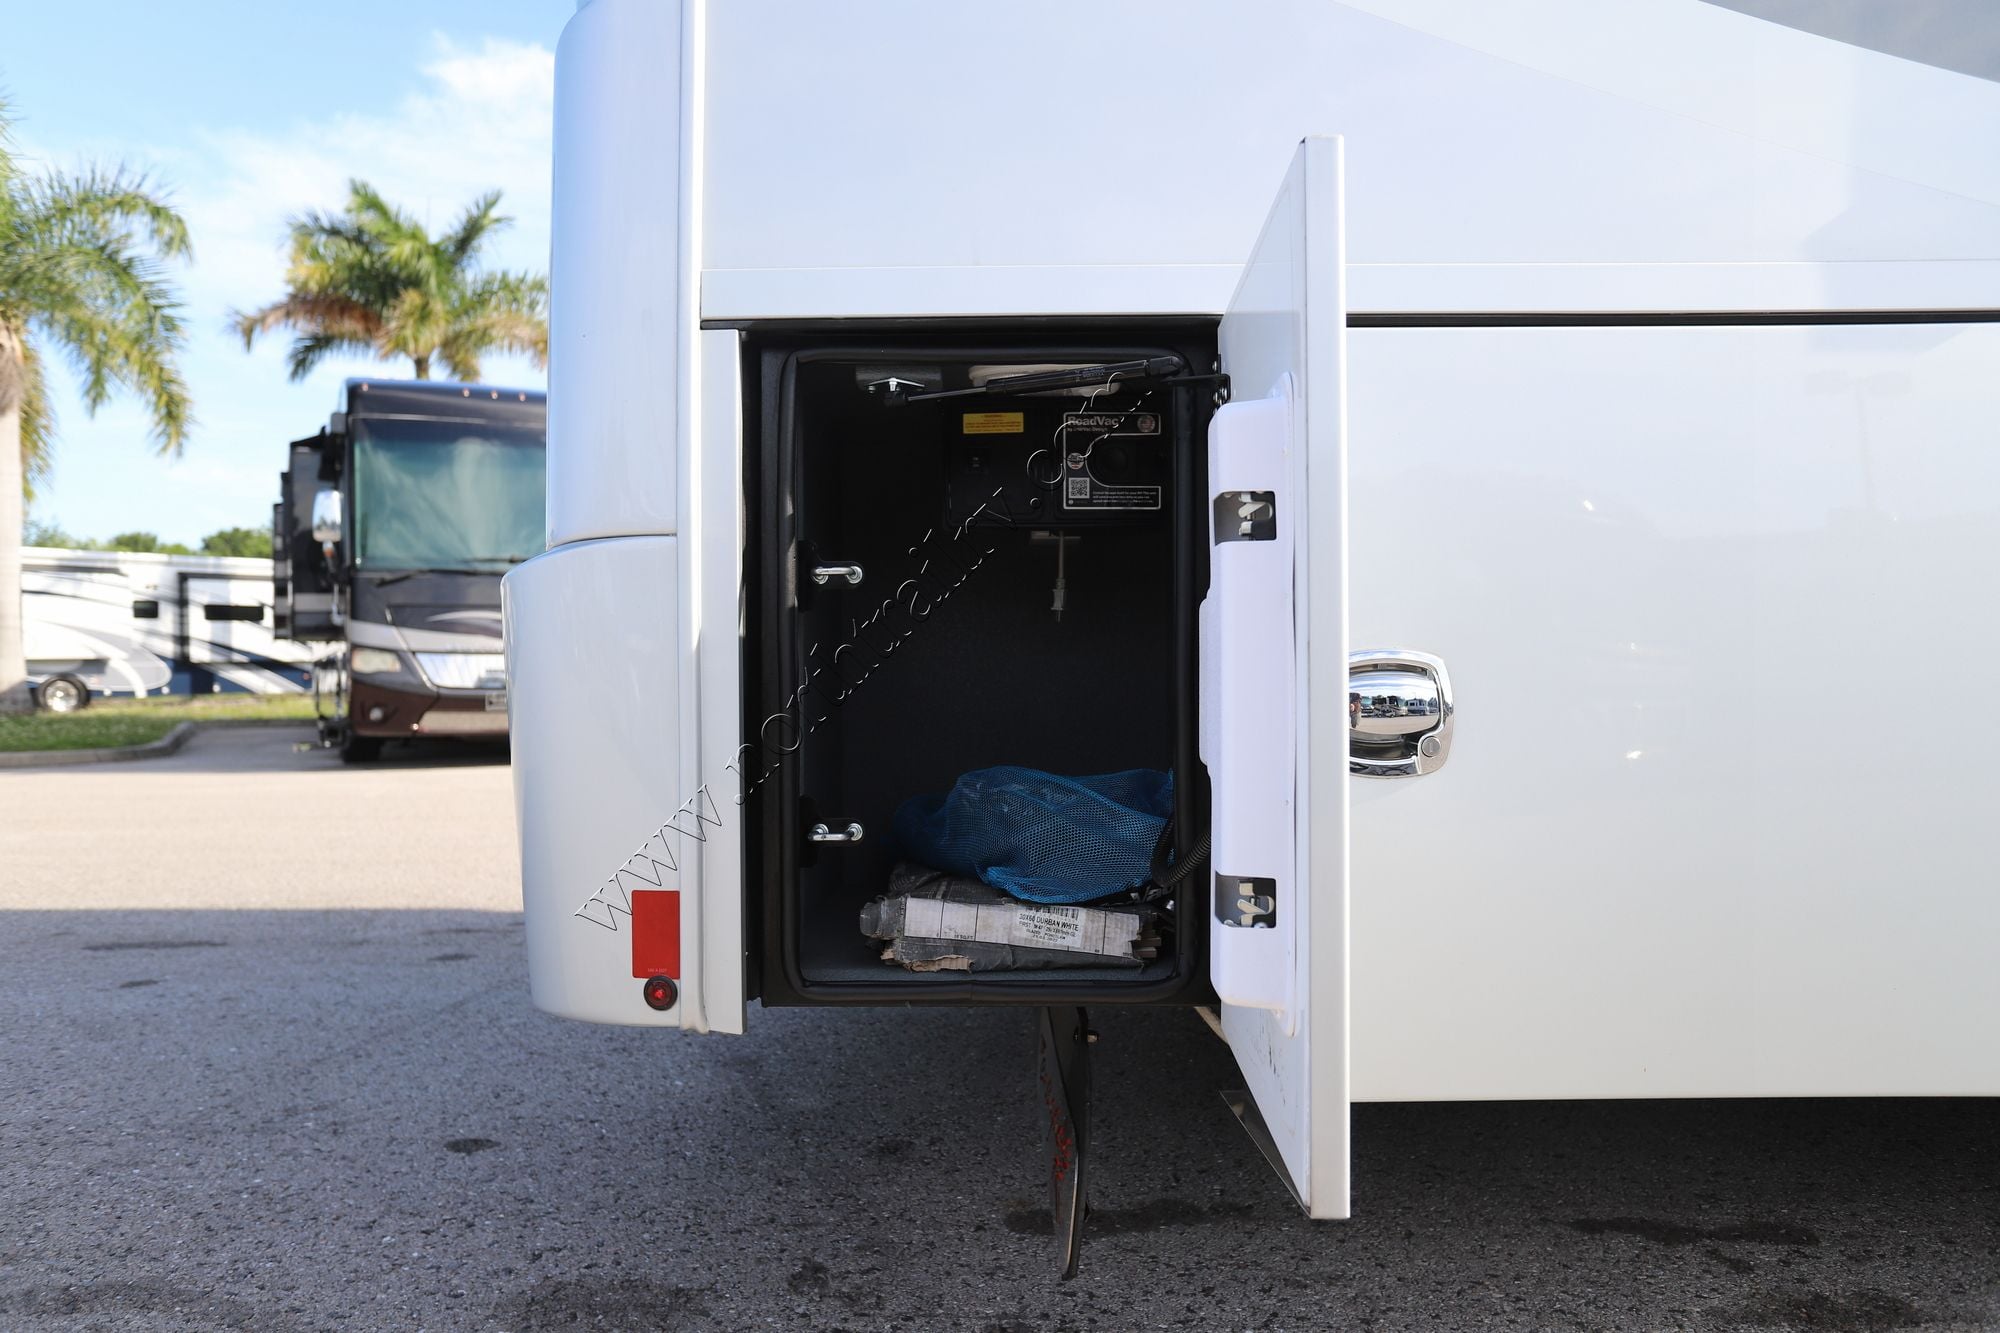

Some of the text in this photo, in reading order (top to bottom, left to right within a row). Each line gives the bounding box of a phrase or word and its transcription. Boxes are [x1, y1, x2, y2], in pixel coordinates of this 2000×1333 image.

[1067, 415, 1119, 426] RoadVac
[1037, 917, 1060, 927] DURBAN
[1061, 921, 1079, 931] WHITE
